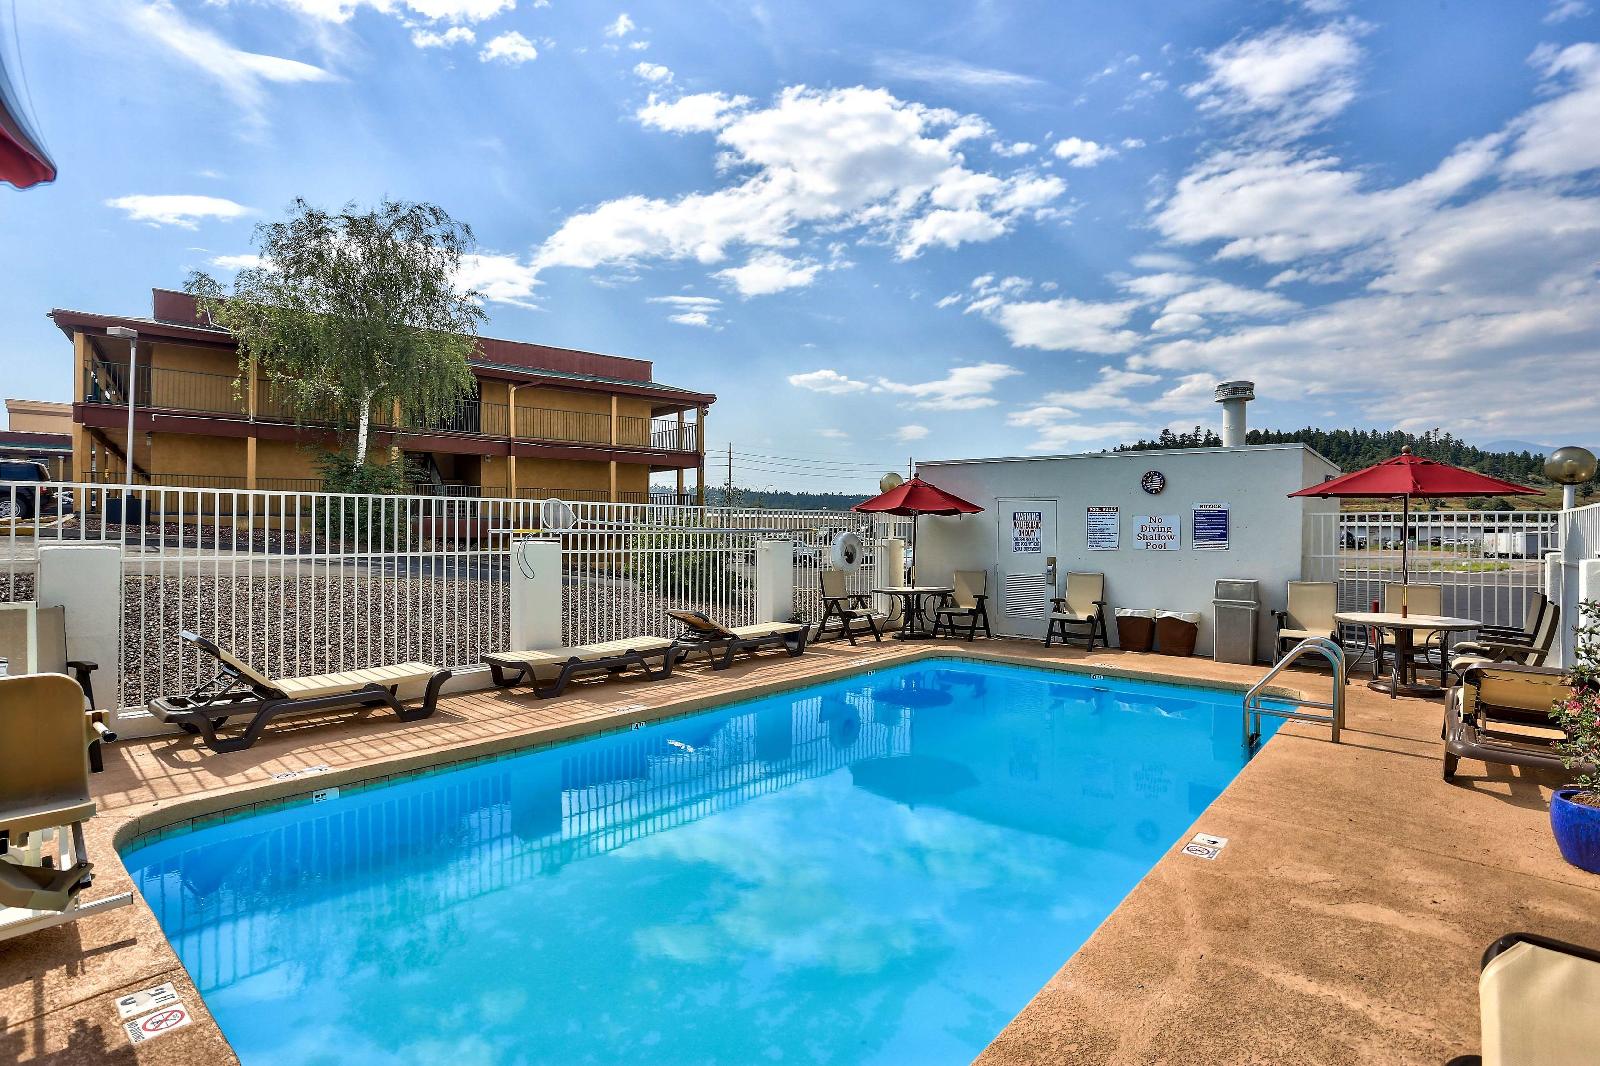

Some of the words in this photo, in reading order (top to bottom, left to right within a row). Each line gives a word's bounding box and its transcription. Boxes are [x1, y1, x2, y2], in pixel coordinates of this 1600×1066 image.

[1015, 512, 1040, 521] WARNING
[1141, 525, 1172, 533] Diving
[1136, 533, 1175, 541] Shallow
[1146, 541, 1166, 549] Pool
